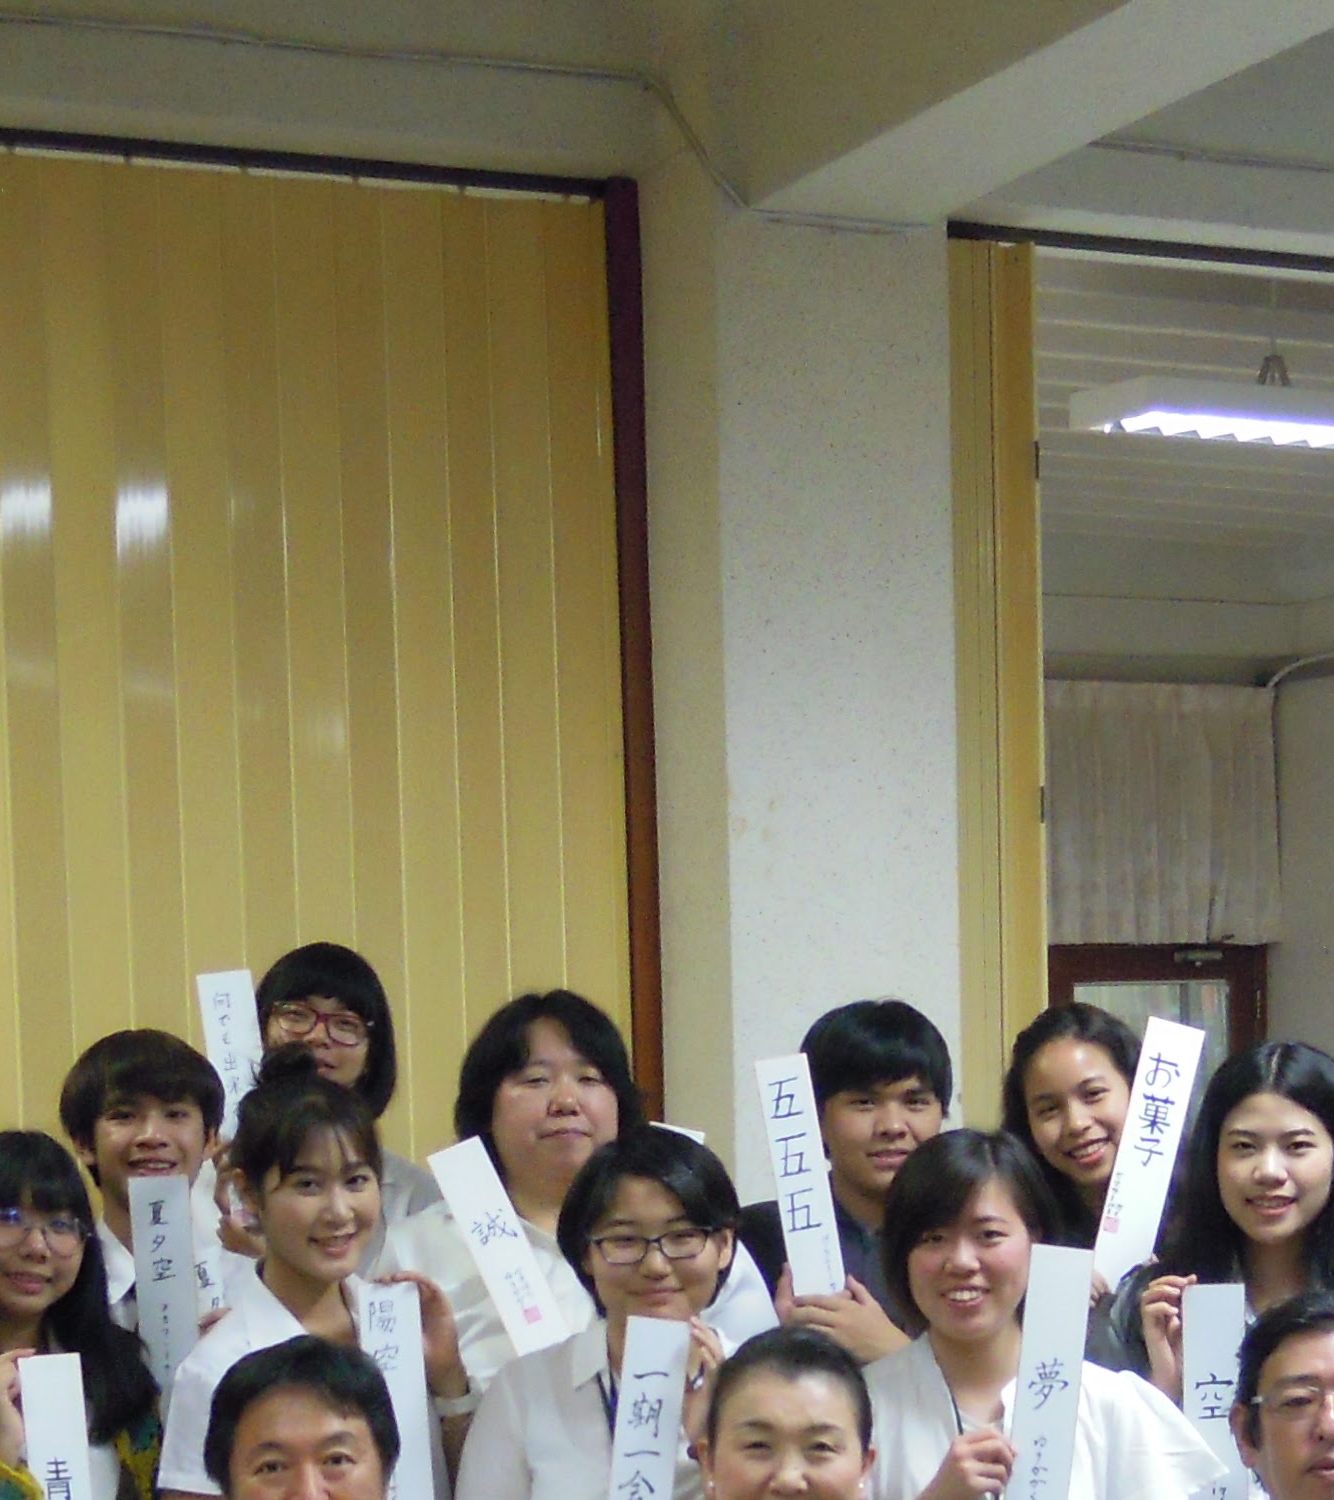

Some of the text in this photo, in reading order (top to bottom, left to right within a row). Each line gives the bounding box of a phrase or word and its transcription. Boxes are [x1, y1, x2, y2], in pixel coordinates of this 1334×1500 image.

[213, 991, 240, 1115] 何でも出来
[1133, 1052, 1181, 1167] お菓子
[768, 1076, 823, 1233] 五五五
[471, 1208, 518, 1246] 誠
[1028, 1357, 1069, 1411] 夢
[1195, 1372, 1235, 1420] 空
